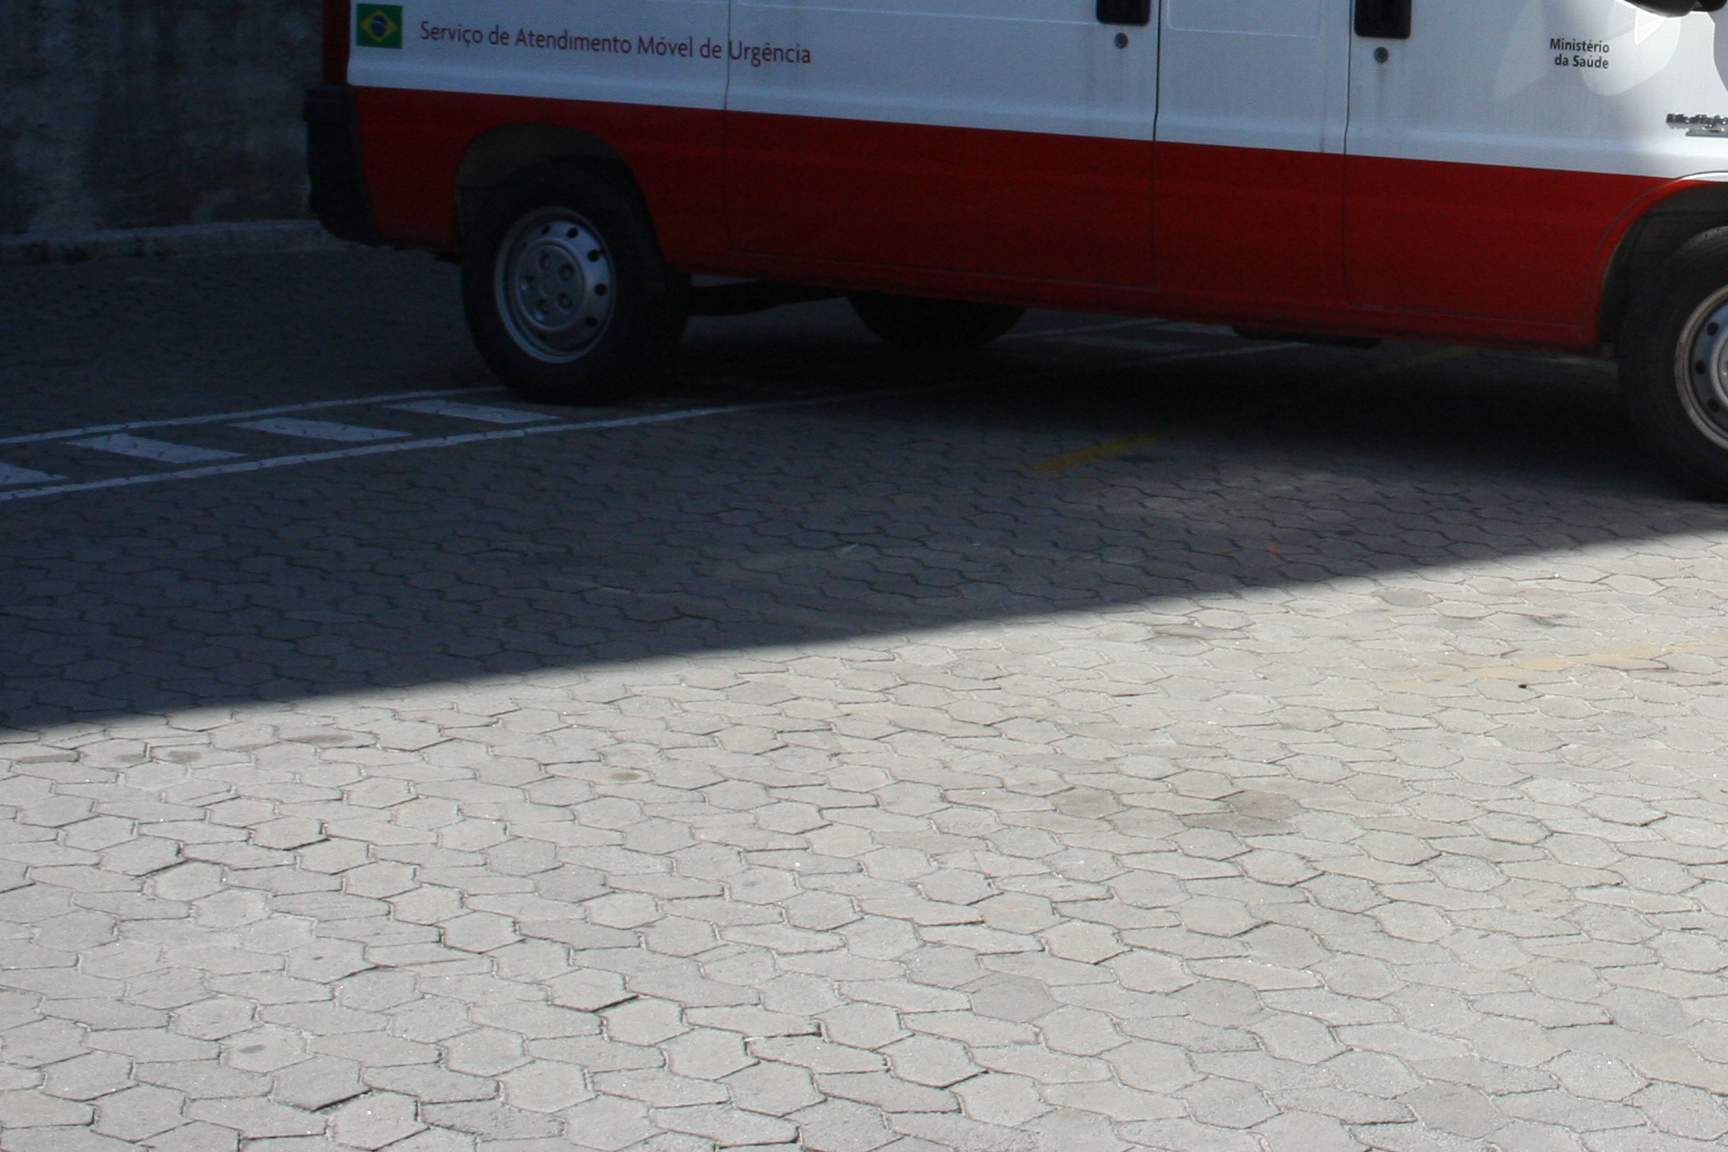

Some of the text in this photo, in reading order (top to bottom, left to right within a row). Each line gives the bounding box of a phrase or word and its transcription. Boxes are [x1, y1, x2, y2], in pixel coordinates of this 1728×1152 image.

[420, 21, 811, 67] Serviço de Atendimento Móvel de Urgência
[1550, 38, 1610, 54] Ministério
[1554, 54, 1609, 69] da Saúde
